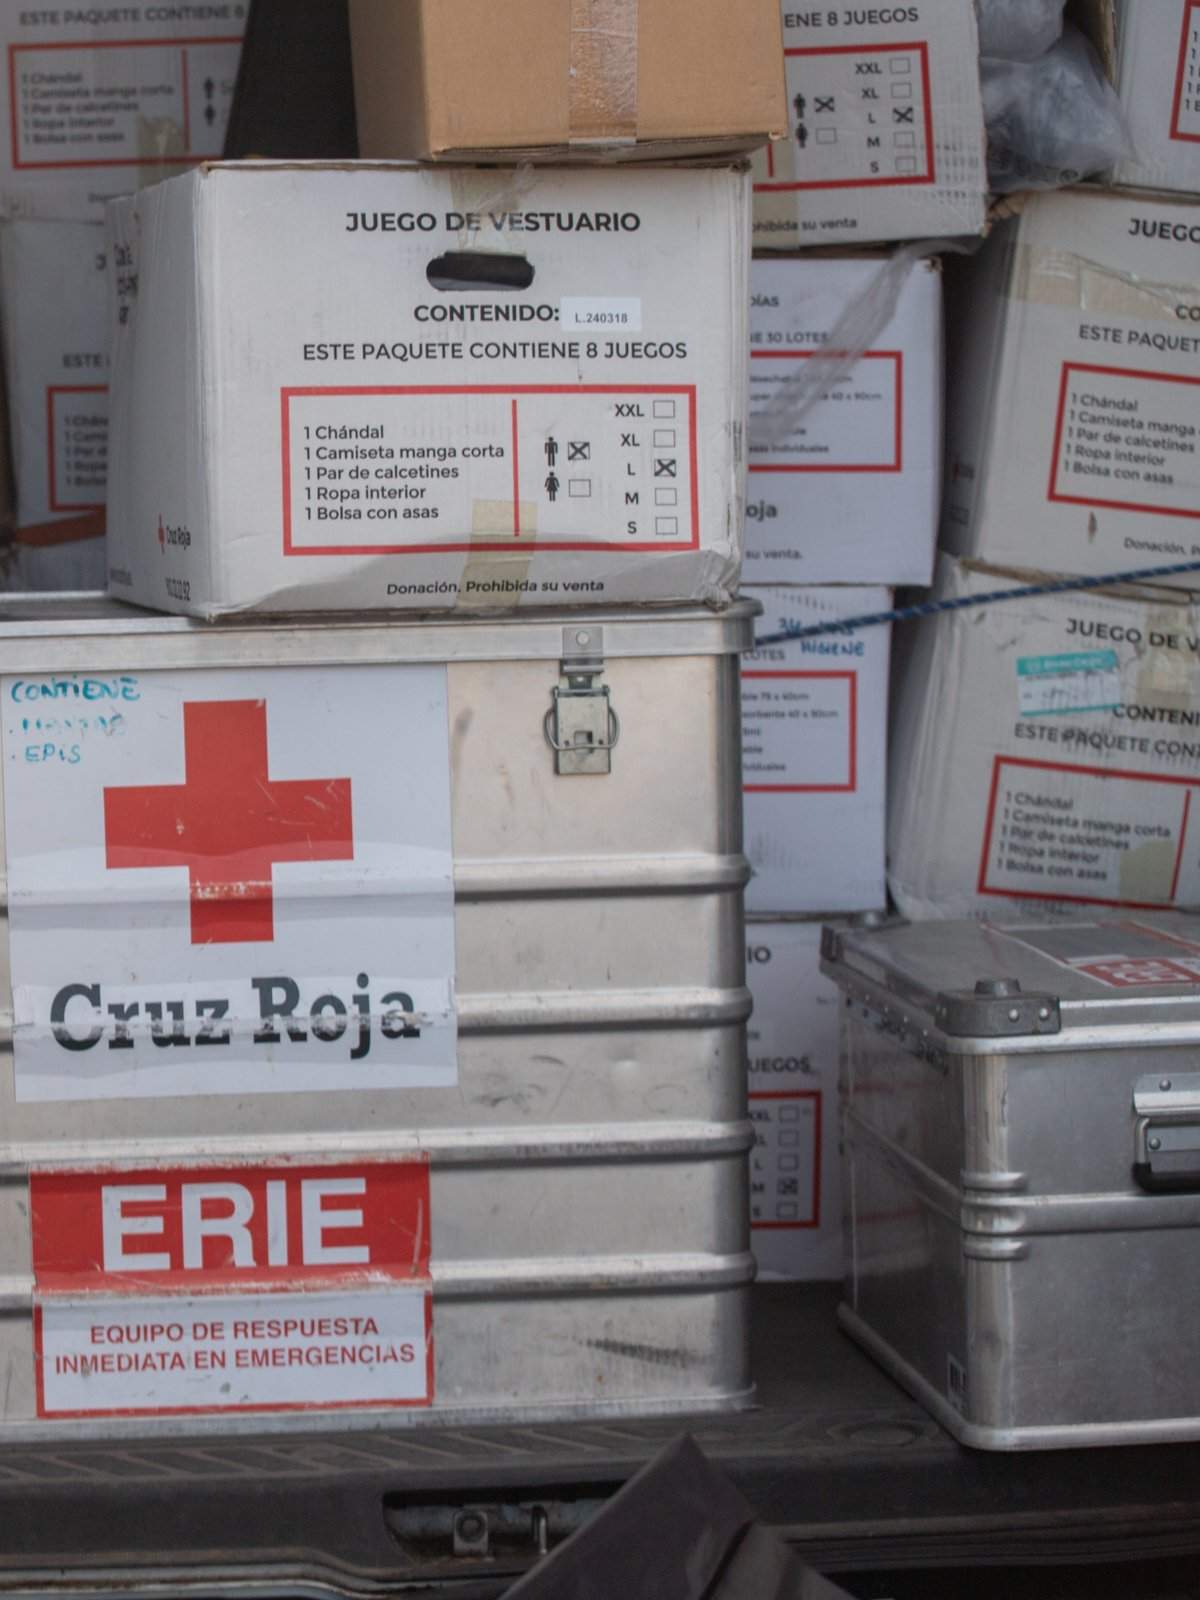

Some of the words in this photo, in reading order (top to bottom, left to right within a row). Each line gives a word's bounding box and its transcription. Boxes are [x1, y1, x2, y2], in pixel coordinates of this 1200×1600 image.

[20, 11, 60, 25] ESTE
[64, 8, 139, 25] PAQUETE
[145, 5, 229, 20] CONTIENE
[828, 12, 839, 26] 8
[843, 8, 919, 26] JUEGOS
[855, 63, 883, 75] XXL
[861, 88, 879, 99] XL
[868, 113, 876, 124] L
[867, 136, 880, 148] M
[870, 162, 879, 174] S
[345, 212, 437, 233] JUEGO
[445, 212, 481, 232] DE
[491, 212, 641, 232] VESTUARIO
[413, 304, 560, 323] CONTENIDO:
[575, 313, 628, 325] L.240318
[1079, 324, 1123, 345] ESTE
[303, 343, 355, 361] ESTE
[362, 342, 463, 362] PAQUETE
[469, 341, 580, 360] CONTIENE
[586, 342, 598, 359] 8
[603, 341, 687, 359] JUEGOS
[614, 404, 645, 417] XXL
[1081, 393, 1138, 411] Chándal
[304, 427, 310, 440] 1
[315, 424, 384, 440] Chándal
[1079, 411, 1144, 430] Camiseta
[1148, 421, 1195, 438] manga
[620, 434, 640, 447] XL
[1077, 427, 1100, 443] Par
[1104, 431, 1121, 445] de
[1125, 436, 1195, 453] calcetines
[304, 447, 310, 460] 1
[315, 445, 395, 460] Camiseta
[399, 449, 458, 463] manga
[462, 445, 505, 458] corta
[1075, 445, 1111, 460] Ropa
[1114, 450, 1166, 466] interior
[304, 467, 310, 480] 1
[316, 466, 345, 480] Par
[349, 465, 370, 480] de
[375, 464, 460, 480] calcetines
[627, 464, 636, 476] L
[1073, 461, 1111, 478] Bolsa
[1113, 468, 1141, 480] con
[1143, 472, 1174, 485] asas
[305, 487, 311, 500] 1
[316, 486, 360, 504] Ropa
[365, 485, 426, 500] interior
[625, 492, 639, 505] M
[305, 507, 311, 520] 1
[317, 506, 362, 520] Bolsa
[366, 509, 399, 520] con
[402, 508, 440, 519] asas
[627, 521, 637, 535] S
[465, 579, 538, 594] Prohibida
[542, 581, 557, 592] su
[561, 580, 604, 592] venta
[1066, 617, 1142, 644] JUEGO
[1149, 630, 1179, 648] DE
[1014, 723, 1059, 743] ESTE
[1061, 726, 1150, 752] PAQUETE
[50, 983, 231, 1052] Cruz
[251, 972, 421, 1061] Roja
[102, 1177, 371, 1273] ERIE
[90, 1322, 184, 1345] EQUIPO
[192, 1321, 226, 1340] DE
[233, 1317, 379, 1340] RESPUESTA
[55, 1352, 186, 1375] INMEDIATA
[193, 1350, 227, 1369] EN
[234, 1343, 416, 1368] EMERGENCIAS
